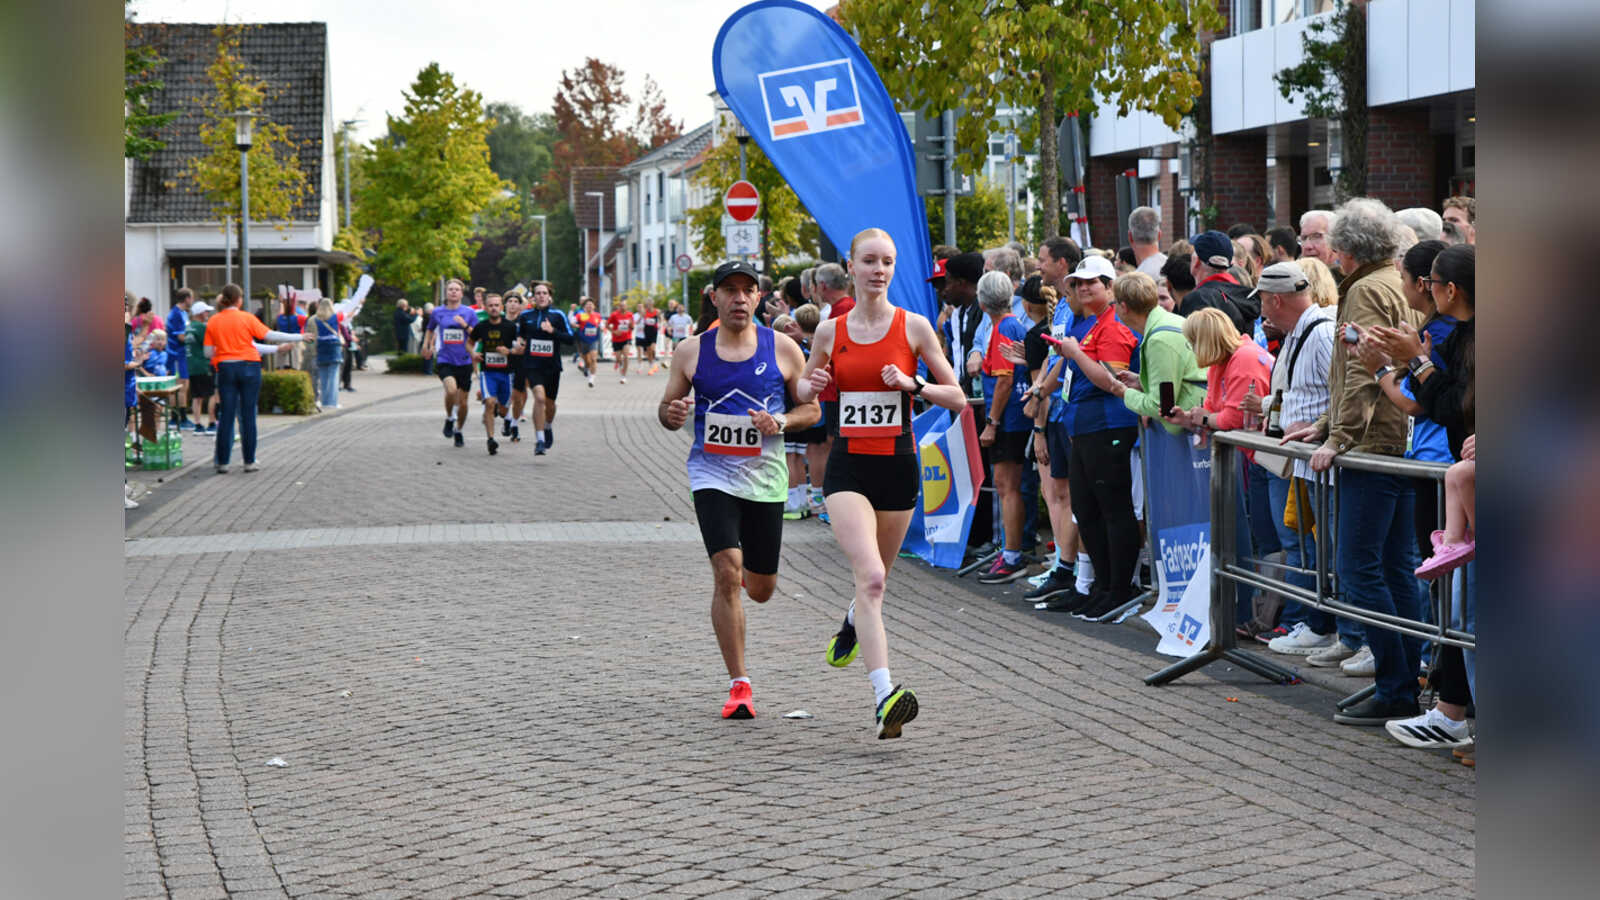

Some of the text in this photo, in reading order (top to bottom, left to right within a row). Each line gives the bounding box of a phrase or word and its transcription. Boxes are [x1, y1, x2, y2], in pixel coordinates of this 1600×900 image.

[532, 343, 552, 352] 2340
[844, 405, 897, 424] 2137
[708, 425, 758, 445] 2016
[923, 466, 947, 481] DL
